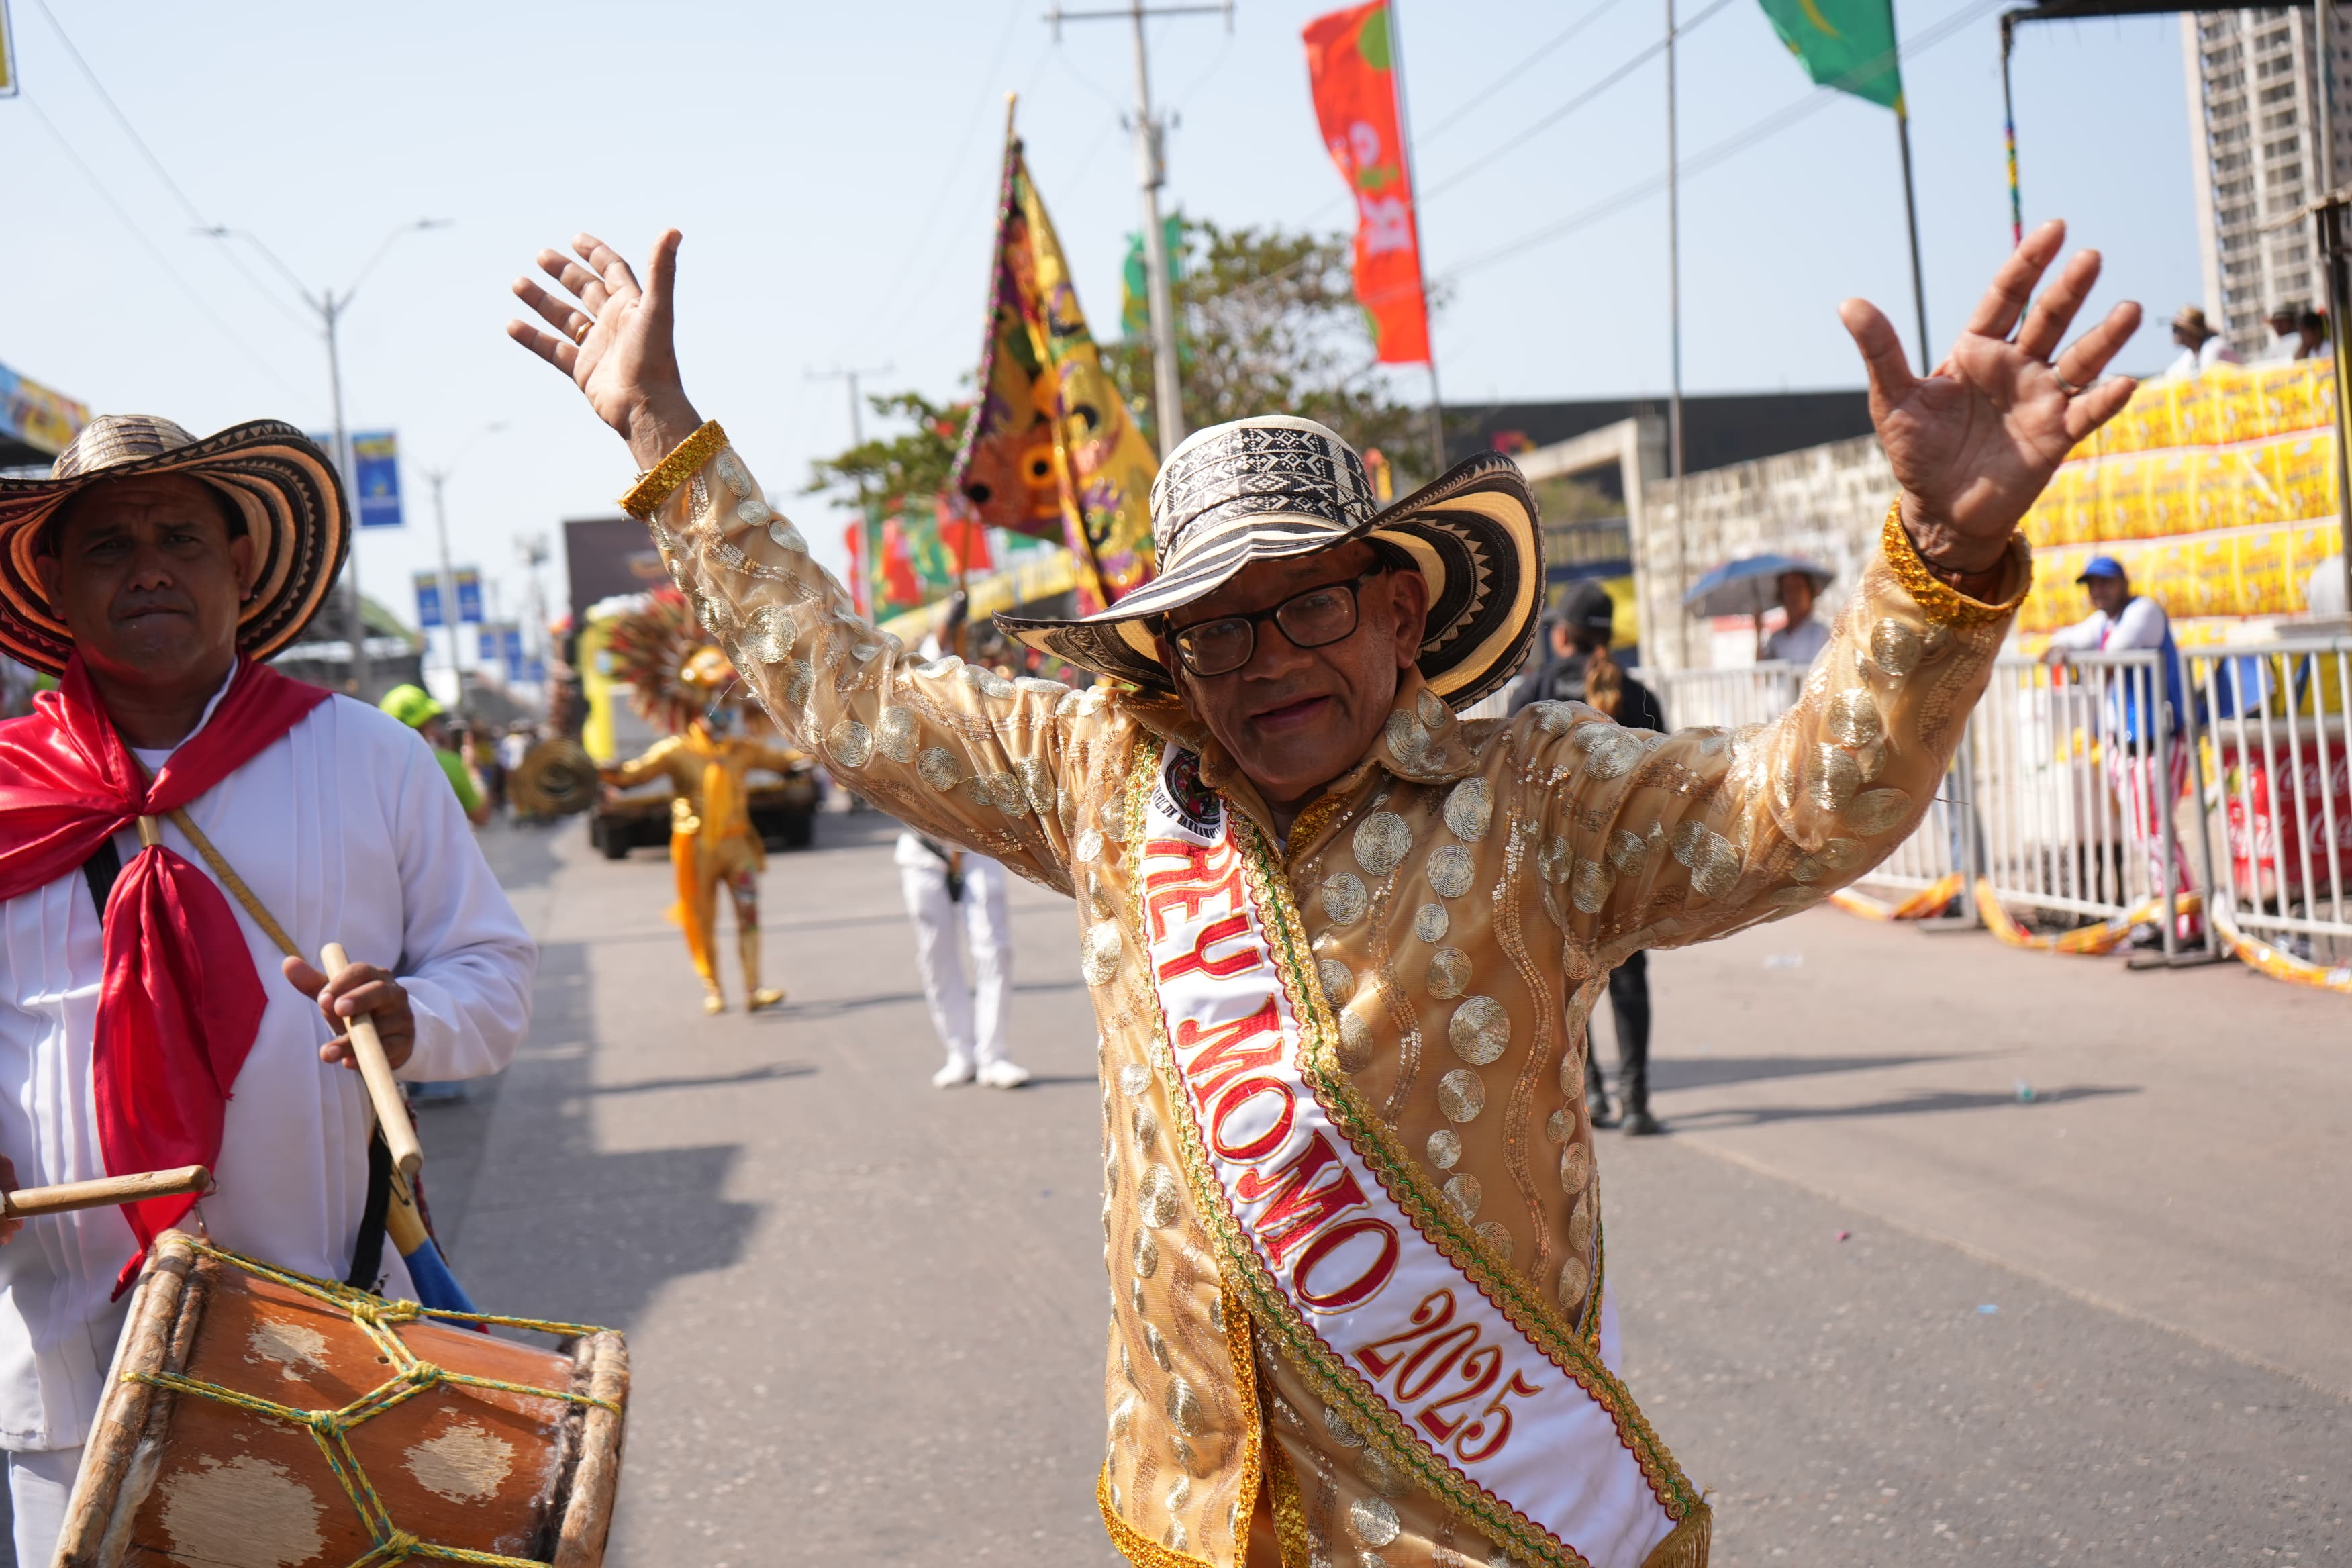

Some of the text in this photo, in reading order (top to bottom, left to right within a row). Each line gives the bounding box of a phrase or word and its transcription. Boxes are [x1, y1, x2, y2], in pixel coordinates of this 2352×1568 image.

[1144, 823, 1544, 1465] REY MOMO 2025
